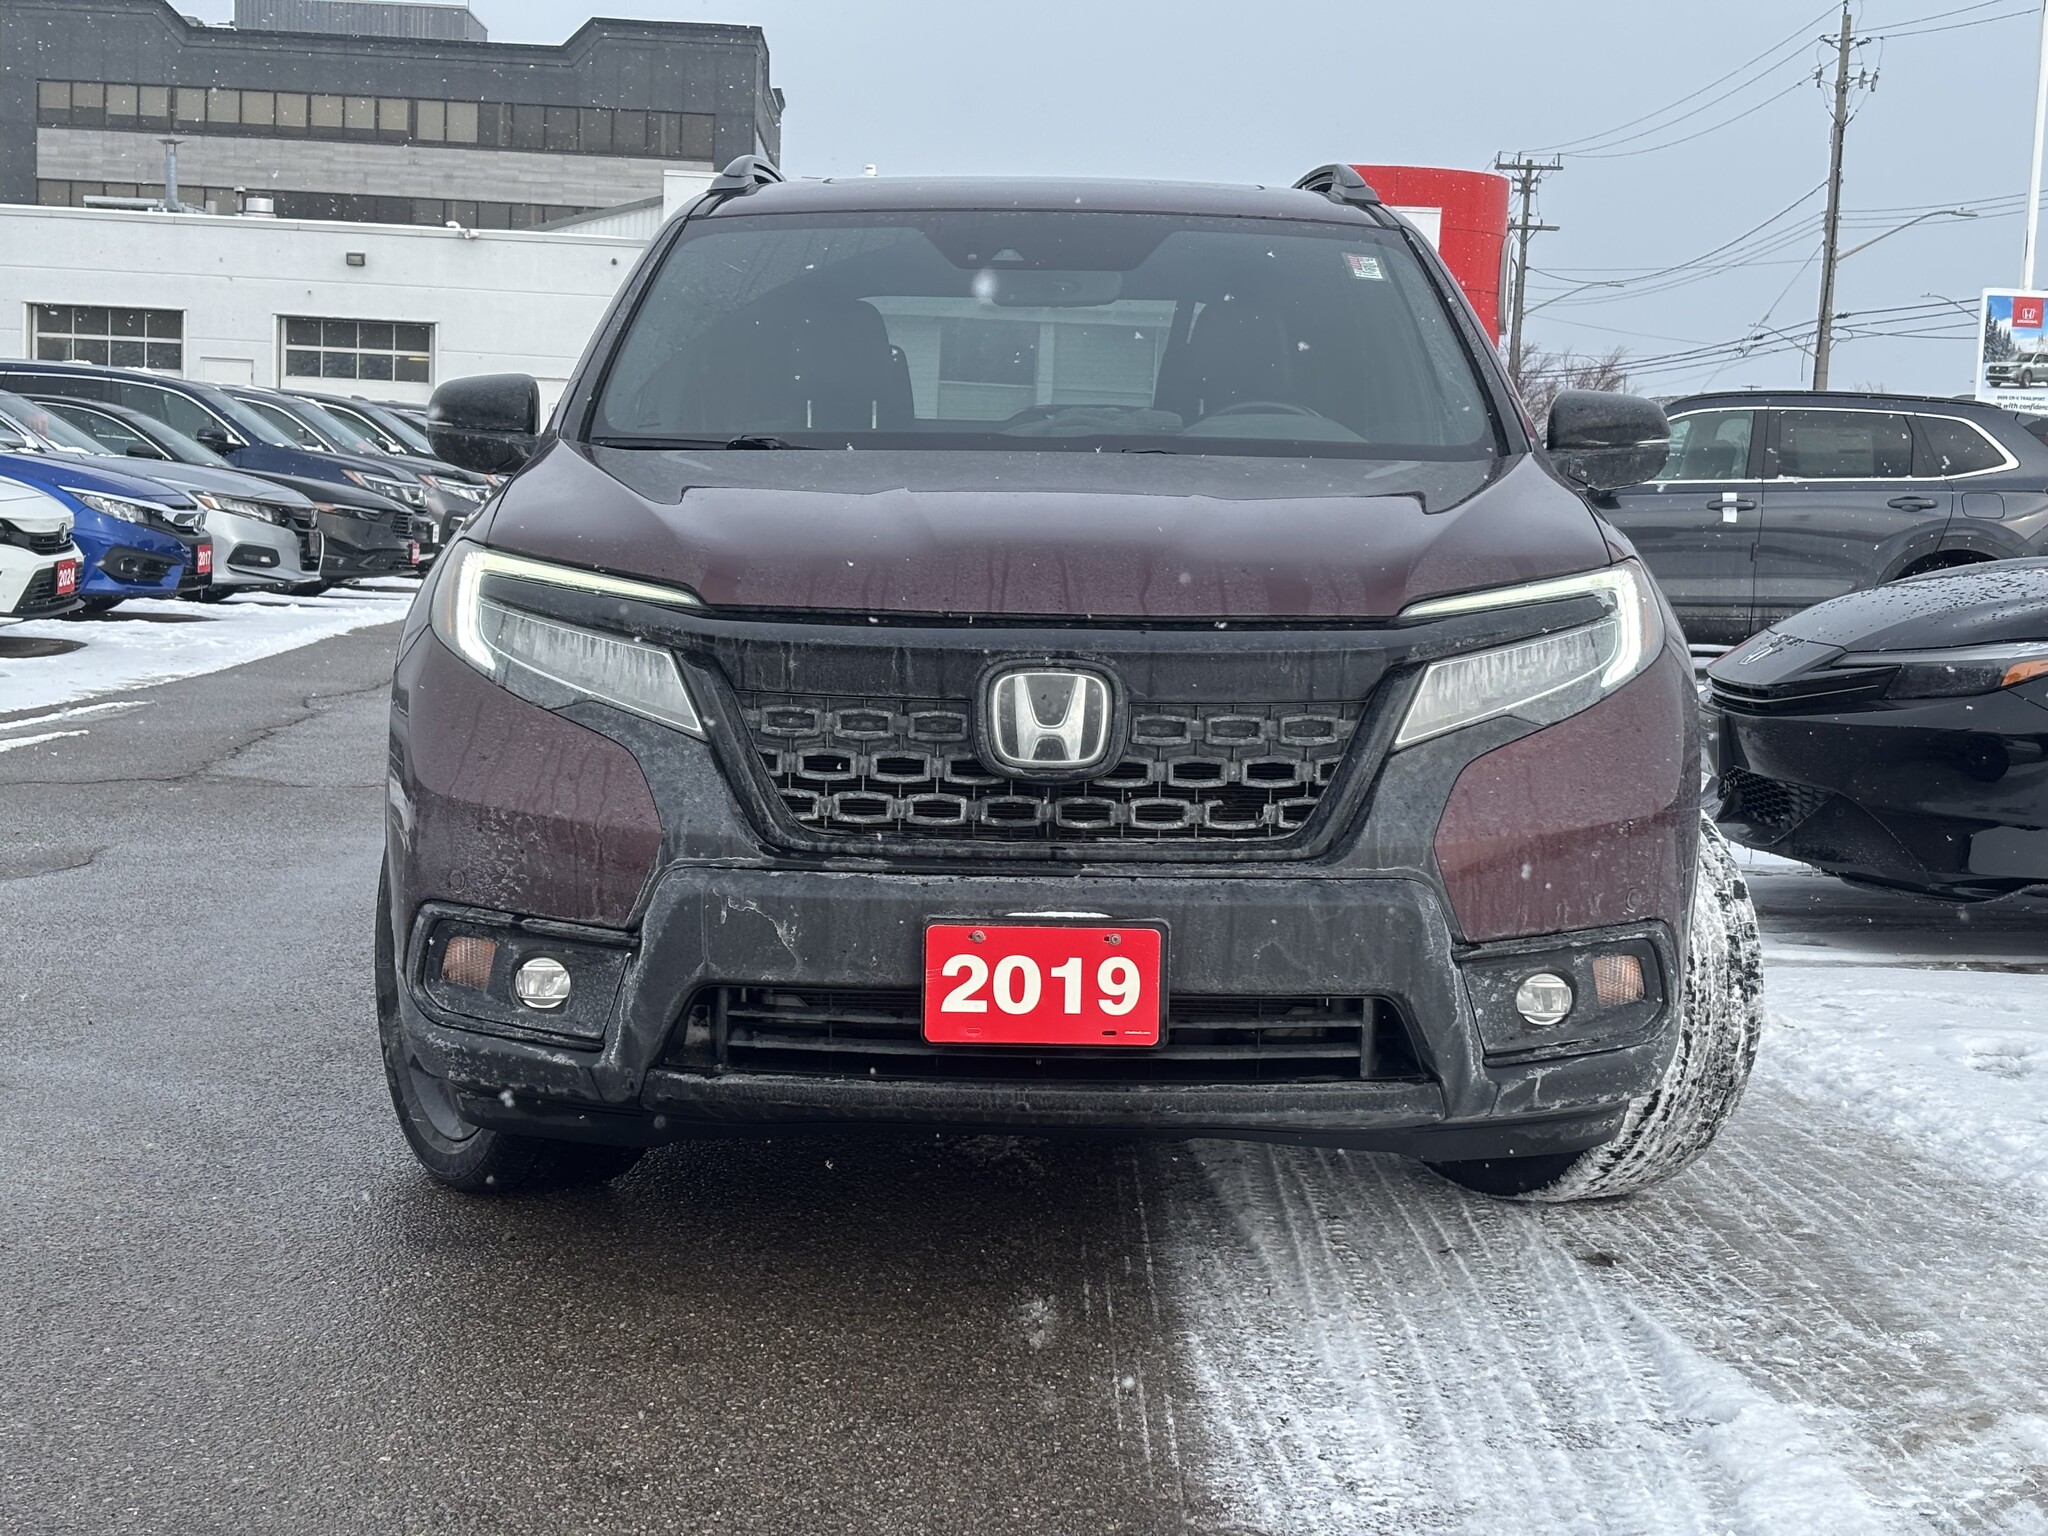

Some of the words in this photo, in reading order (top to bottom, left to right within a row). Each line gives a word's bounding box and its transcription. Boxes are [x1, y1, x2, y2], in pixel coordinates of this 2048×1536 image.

[2003, 402, 2018, 410] with
[198, 550, 211, 566] 2017
[58, 567, 75, 587] 2024
[940, 953, 1141, 1016] 2019
